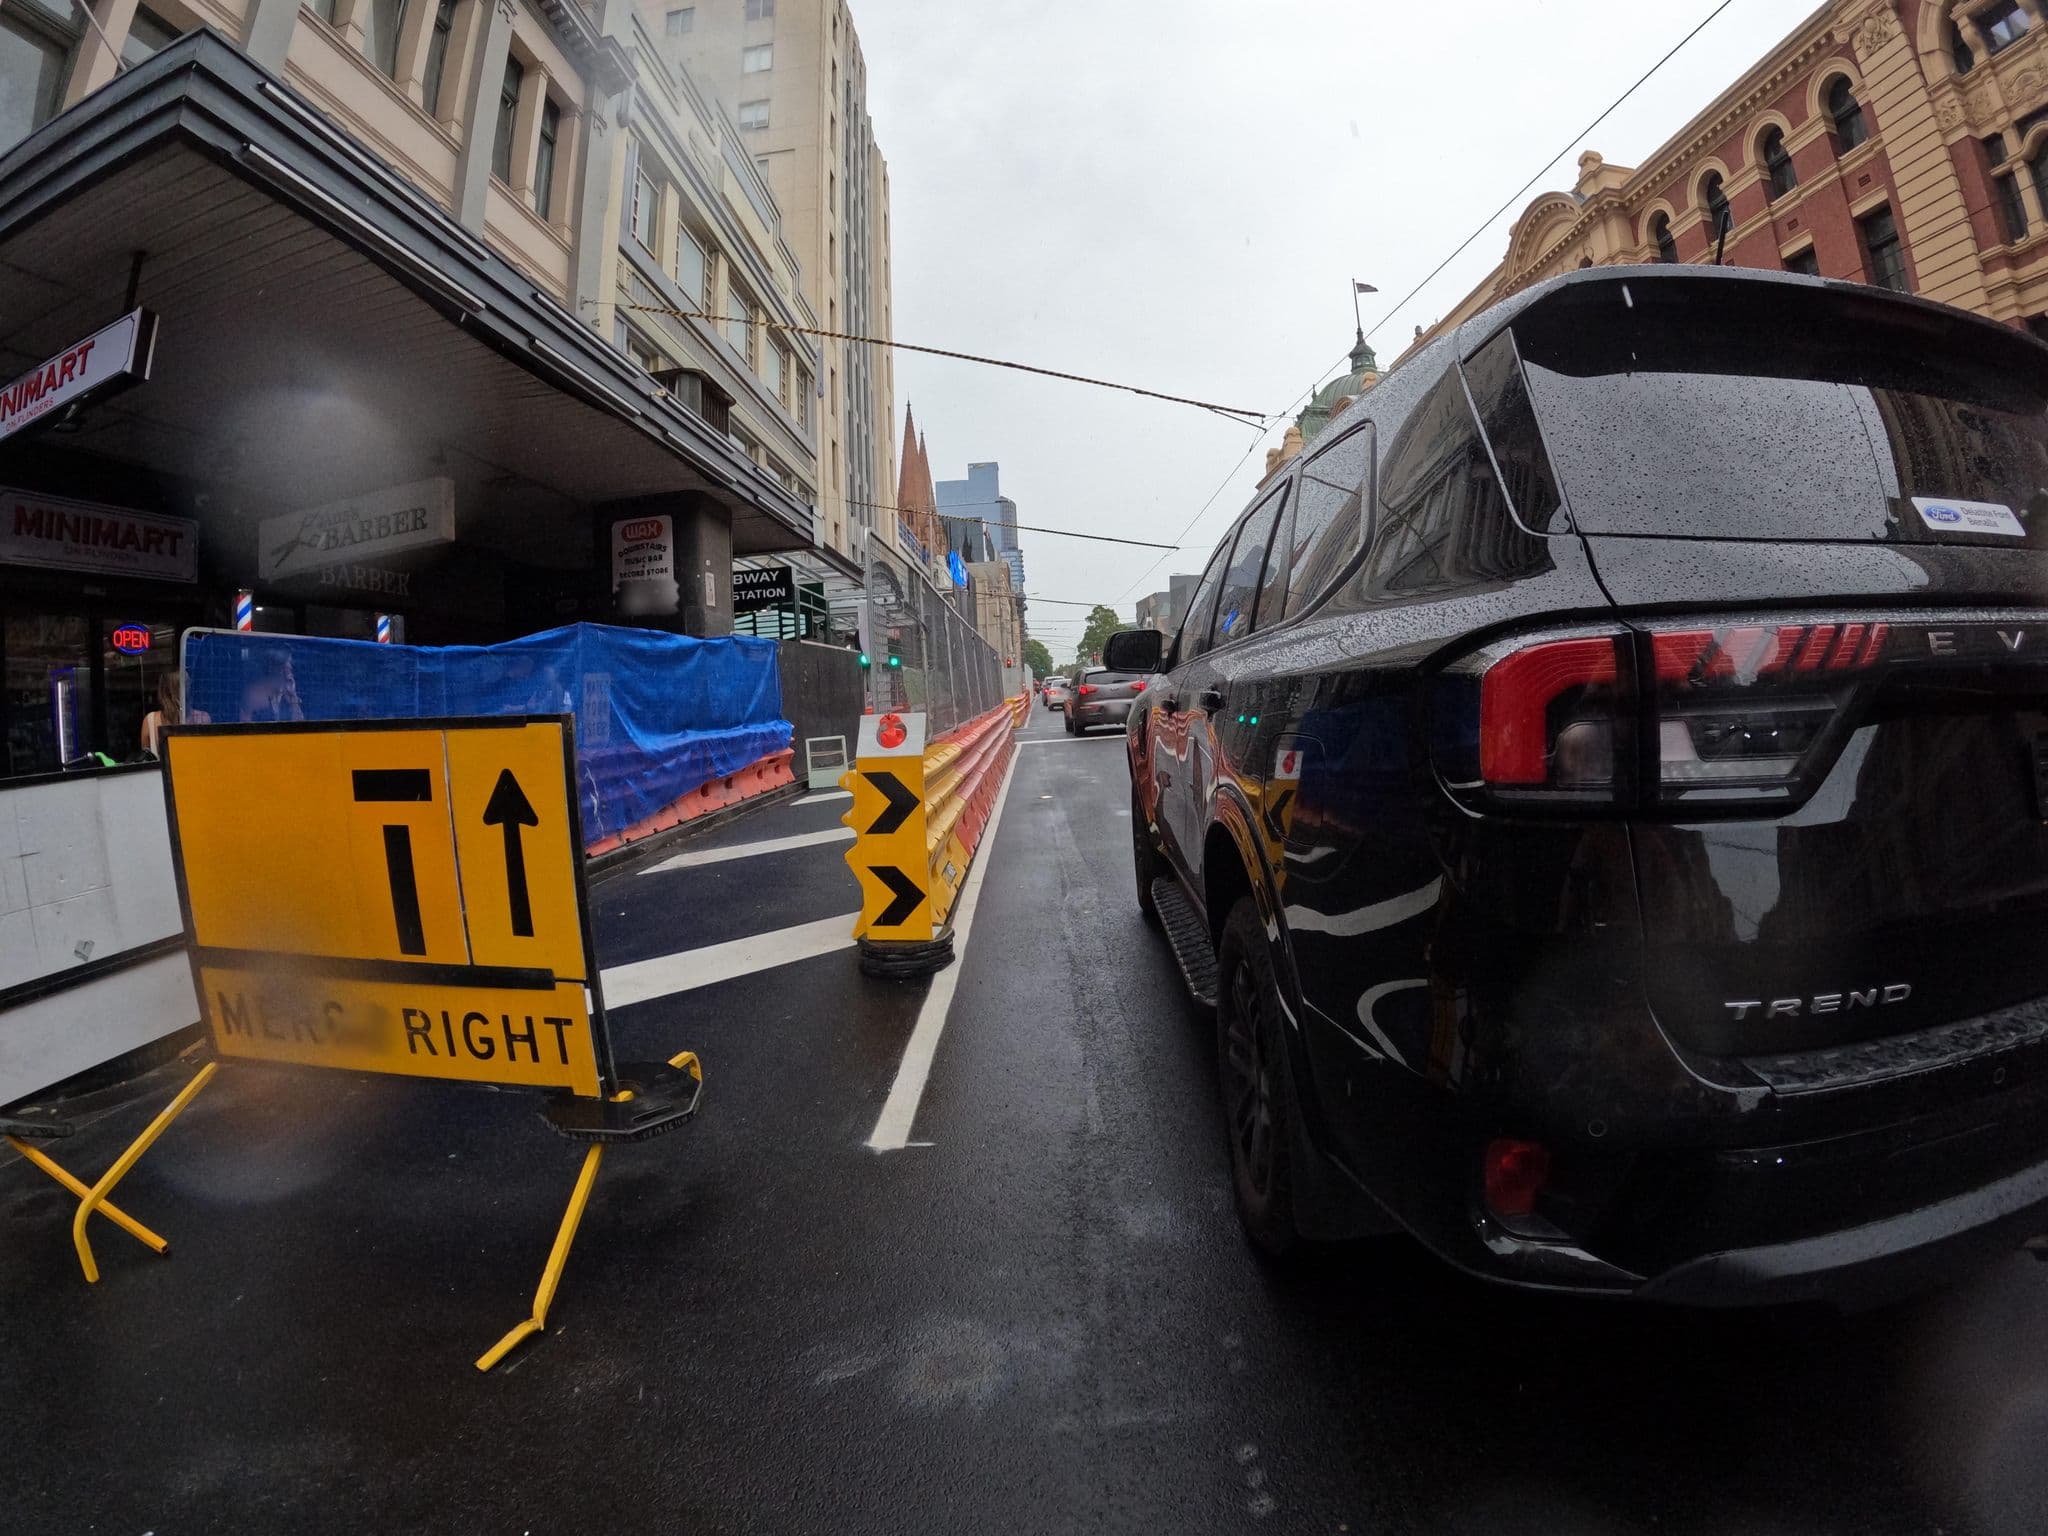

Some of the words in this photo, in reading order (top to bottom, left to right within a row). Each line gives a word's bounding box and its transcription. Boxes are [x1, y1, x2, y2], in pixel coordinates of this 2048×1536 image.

[14, 504, 184, 558] MINIMART
[320, 507, 428, 551] BARBER
[320, 565, 411, 596] BARBER
[646, 567, 669, 576] STORE
[732, 587, 786, 601] STATION
[113, 631, 150, 649] OPEN
[1724, 984, 1912, 1020] TREND
[401, 1007, 574, 1066] RIGHT
